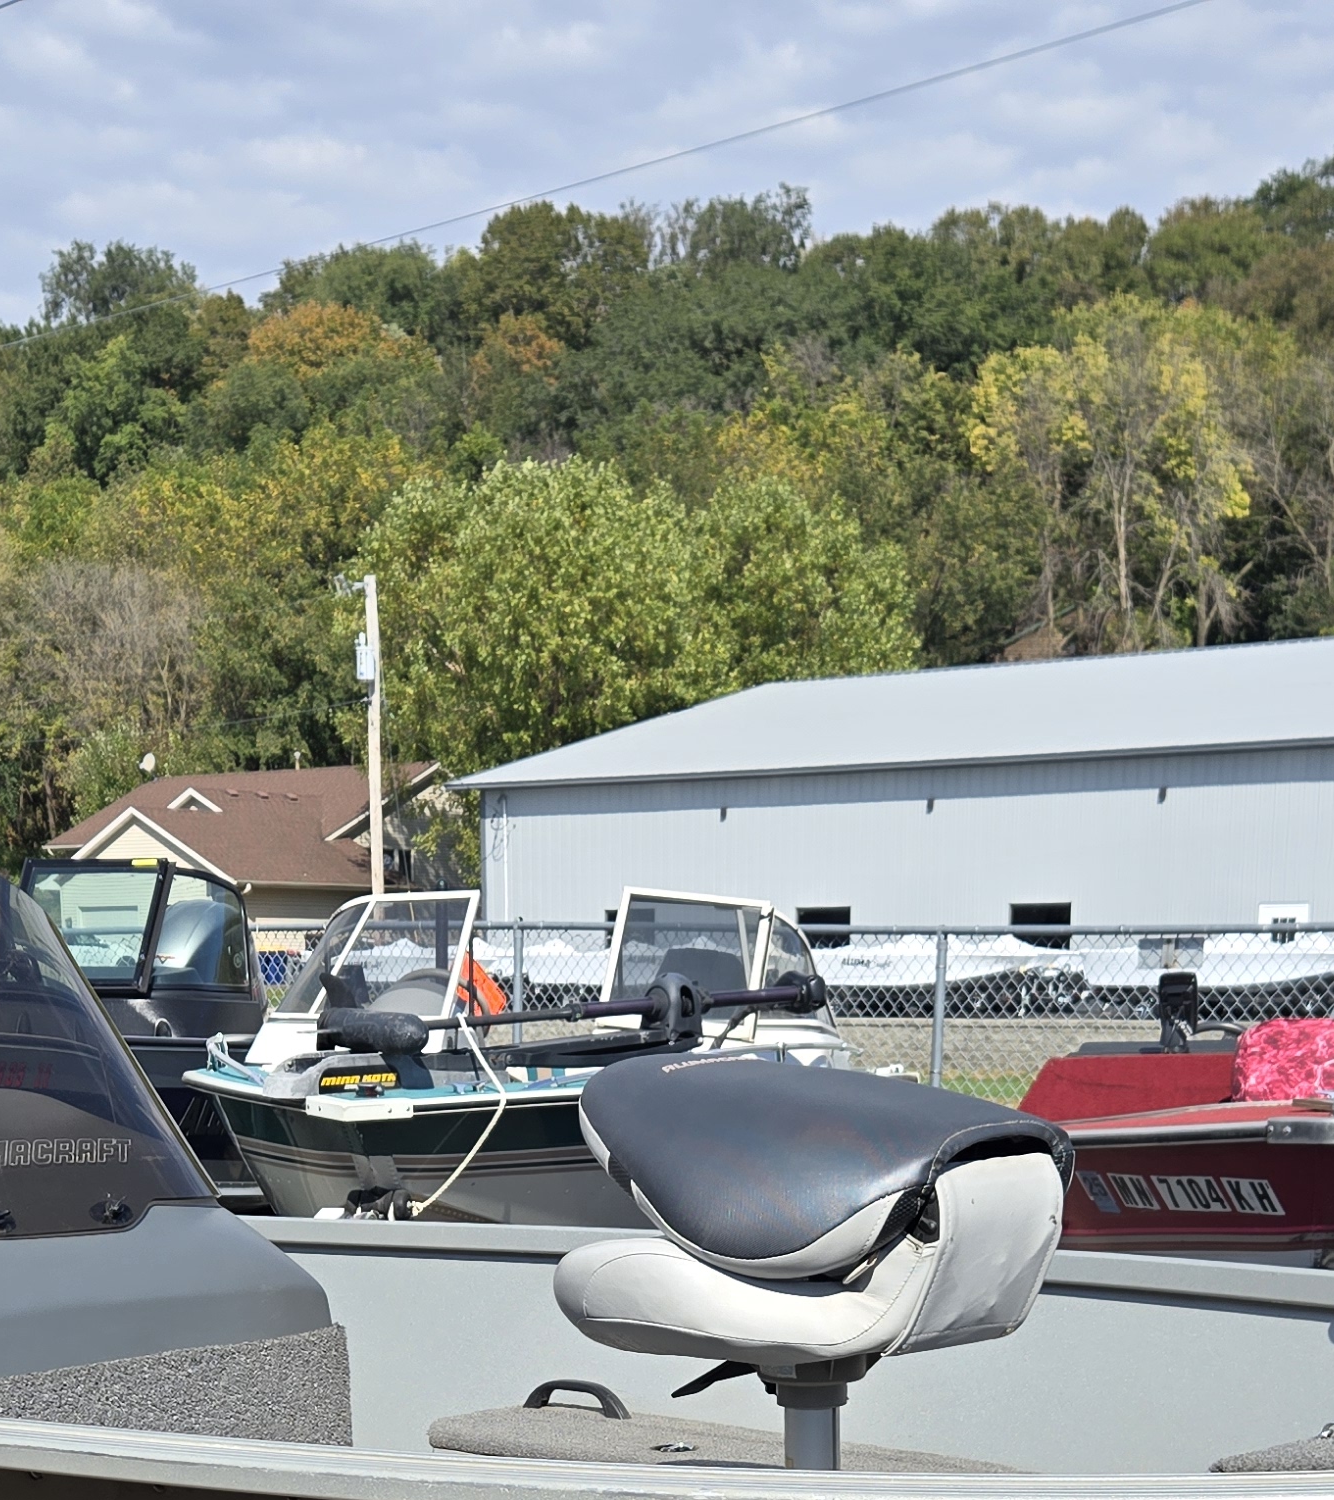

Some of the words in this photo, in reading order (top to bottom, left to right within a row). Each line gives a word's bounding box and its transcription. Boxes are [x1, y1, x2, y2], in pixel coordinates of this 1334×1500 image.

[1111, 1175, 1154, 1208] MN
[1157, 1177, 1227, 1210] 7104
[1226, 1179, 1278, 1213] KH
